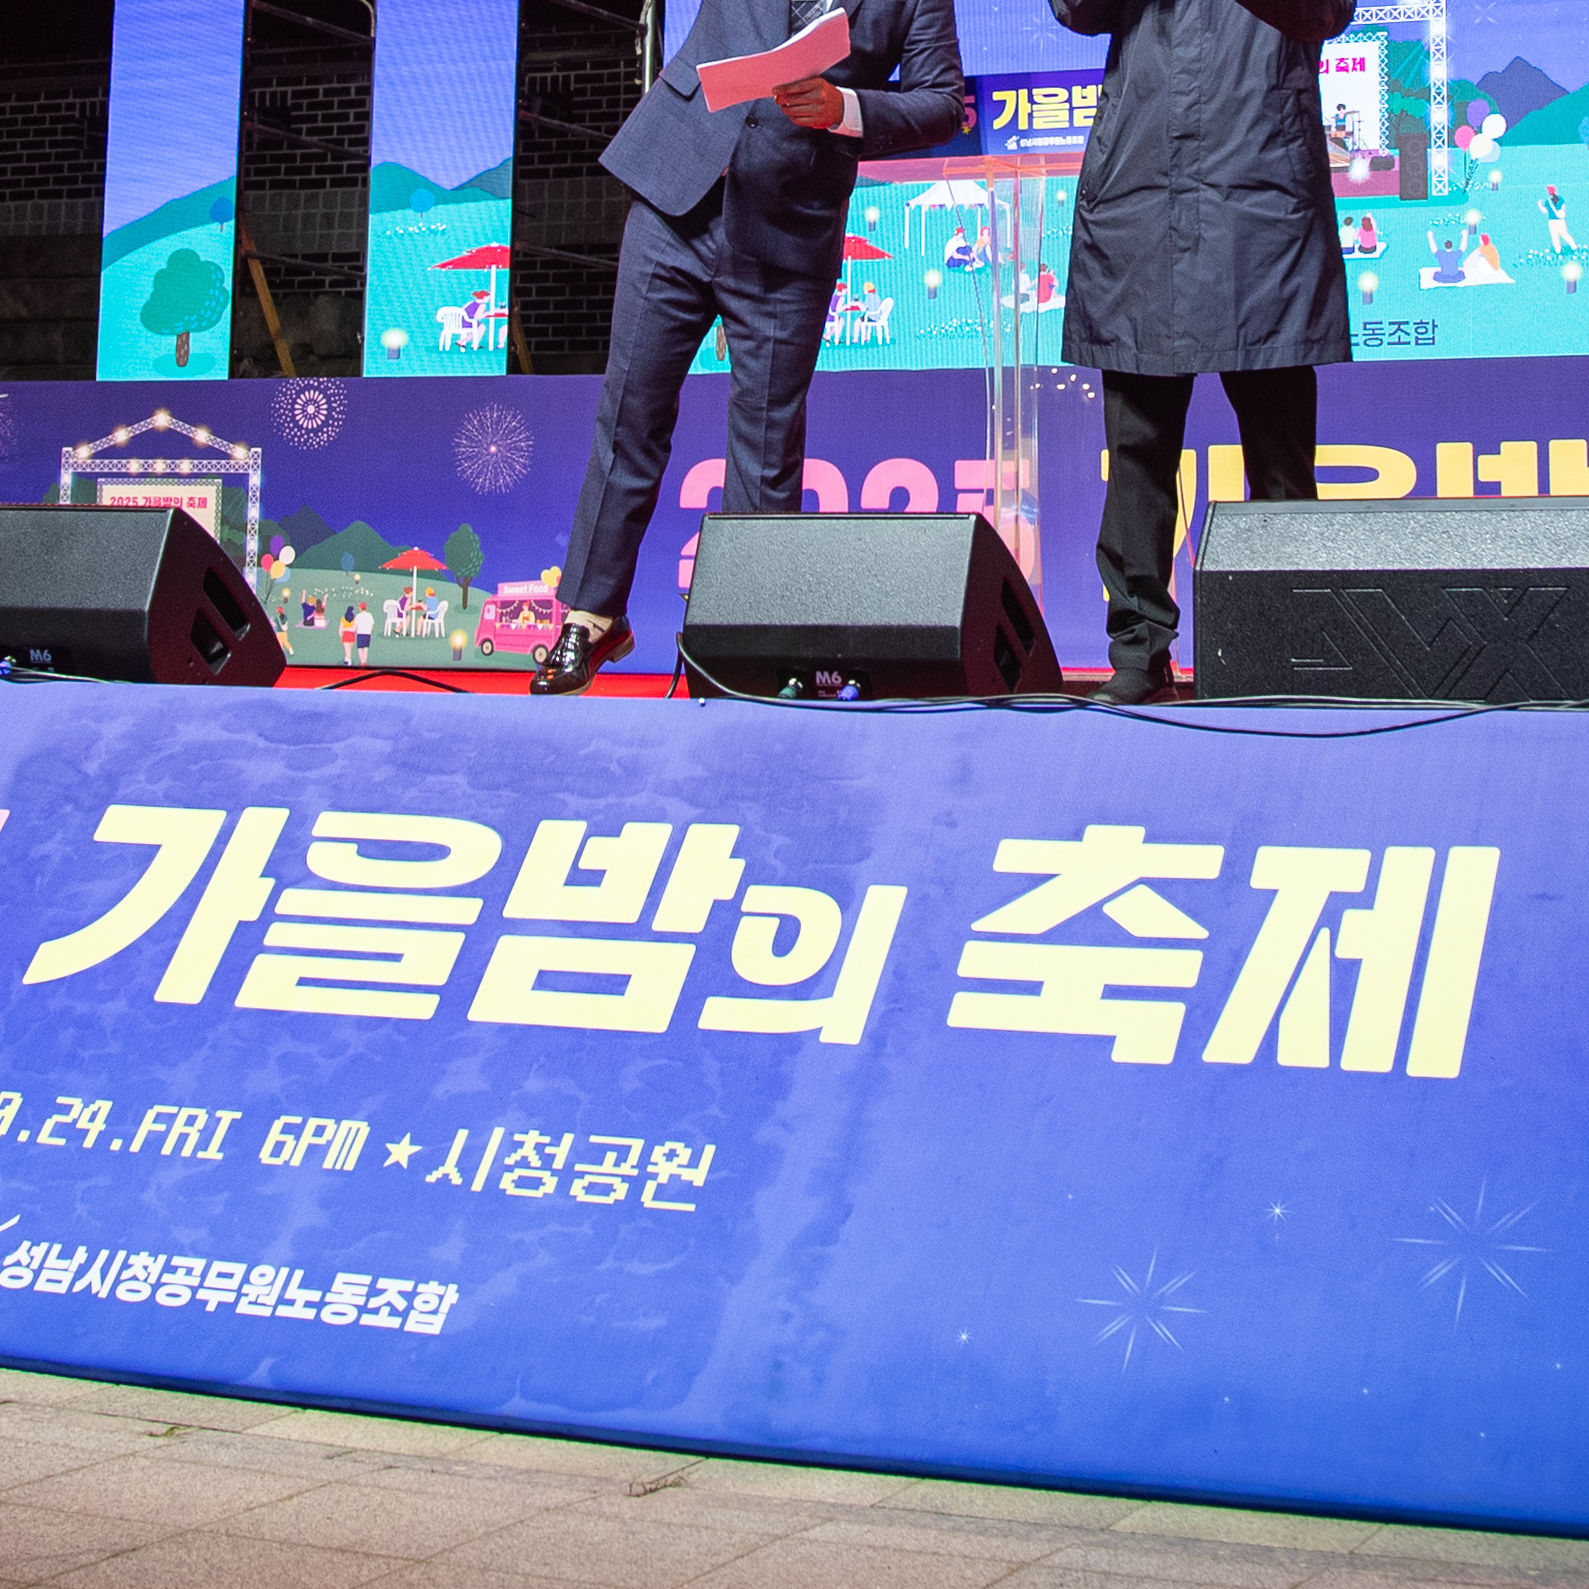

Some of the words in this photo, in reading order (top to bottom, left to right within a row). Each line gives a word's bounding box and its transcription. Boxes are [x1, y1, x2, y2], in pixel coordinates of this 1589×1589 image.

[992, 84, 1103, 131] 가을밤
[29, 648, 52, 662] M6
[815, 670, 842, 685] M6
[22, 803, 908, 1046] 가을밤의
[946, 824, 1501, 1079] 축제
[258, 1113, 371, 1173] 6PM
[425, 1125, 718, 1214] 시청공원
